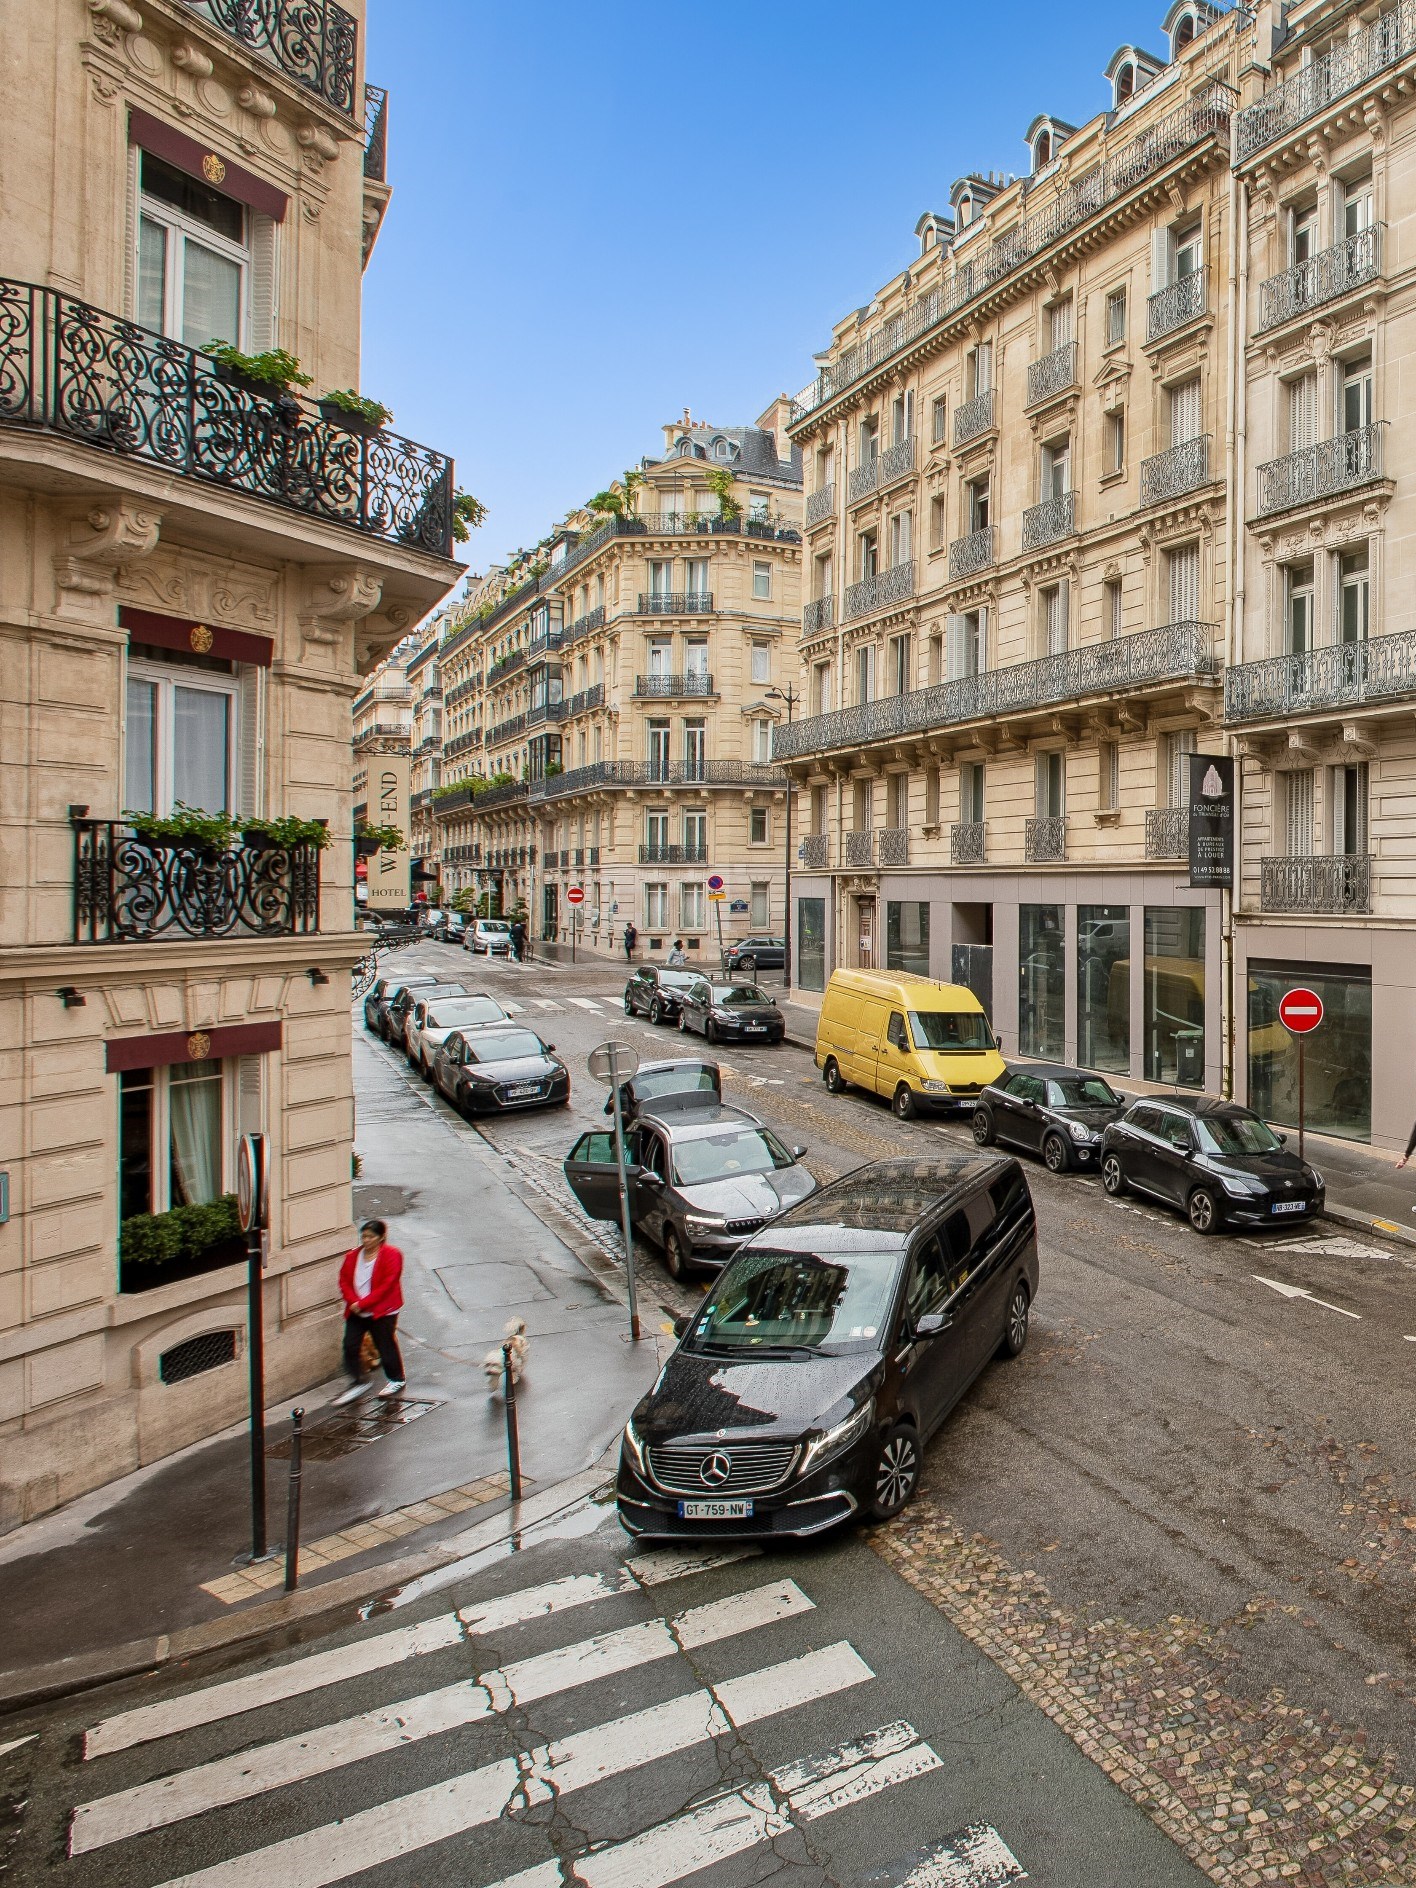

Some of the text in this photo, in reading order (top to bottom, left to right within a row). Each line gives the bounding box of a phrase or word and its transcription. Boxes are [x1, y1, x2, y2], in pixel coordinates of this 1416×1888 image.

[1193, 804, 1230, 812] FONCIÈRE
[381, 772, 397, 875] WET-END
[371, 889, 407, 897] HOTEL
[686, 1504, 744, 1515] GT-759-NW
